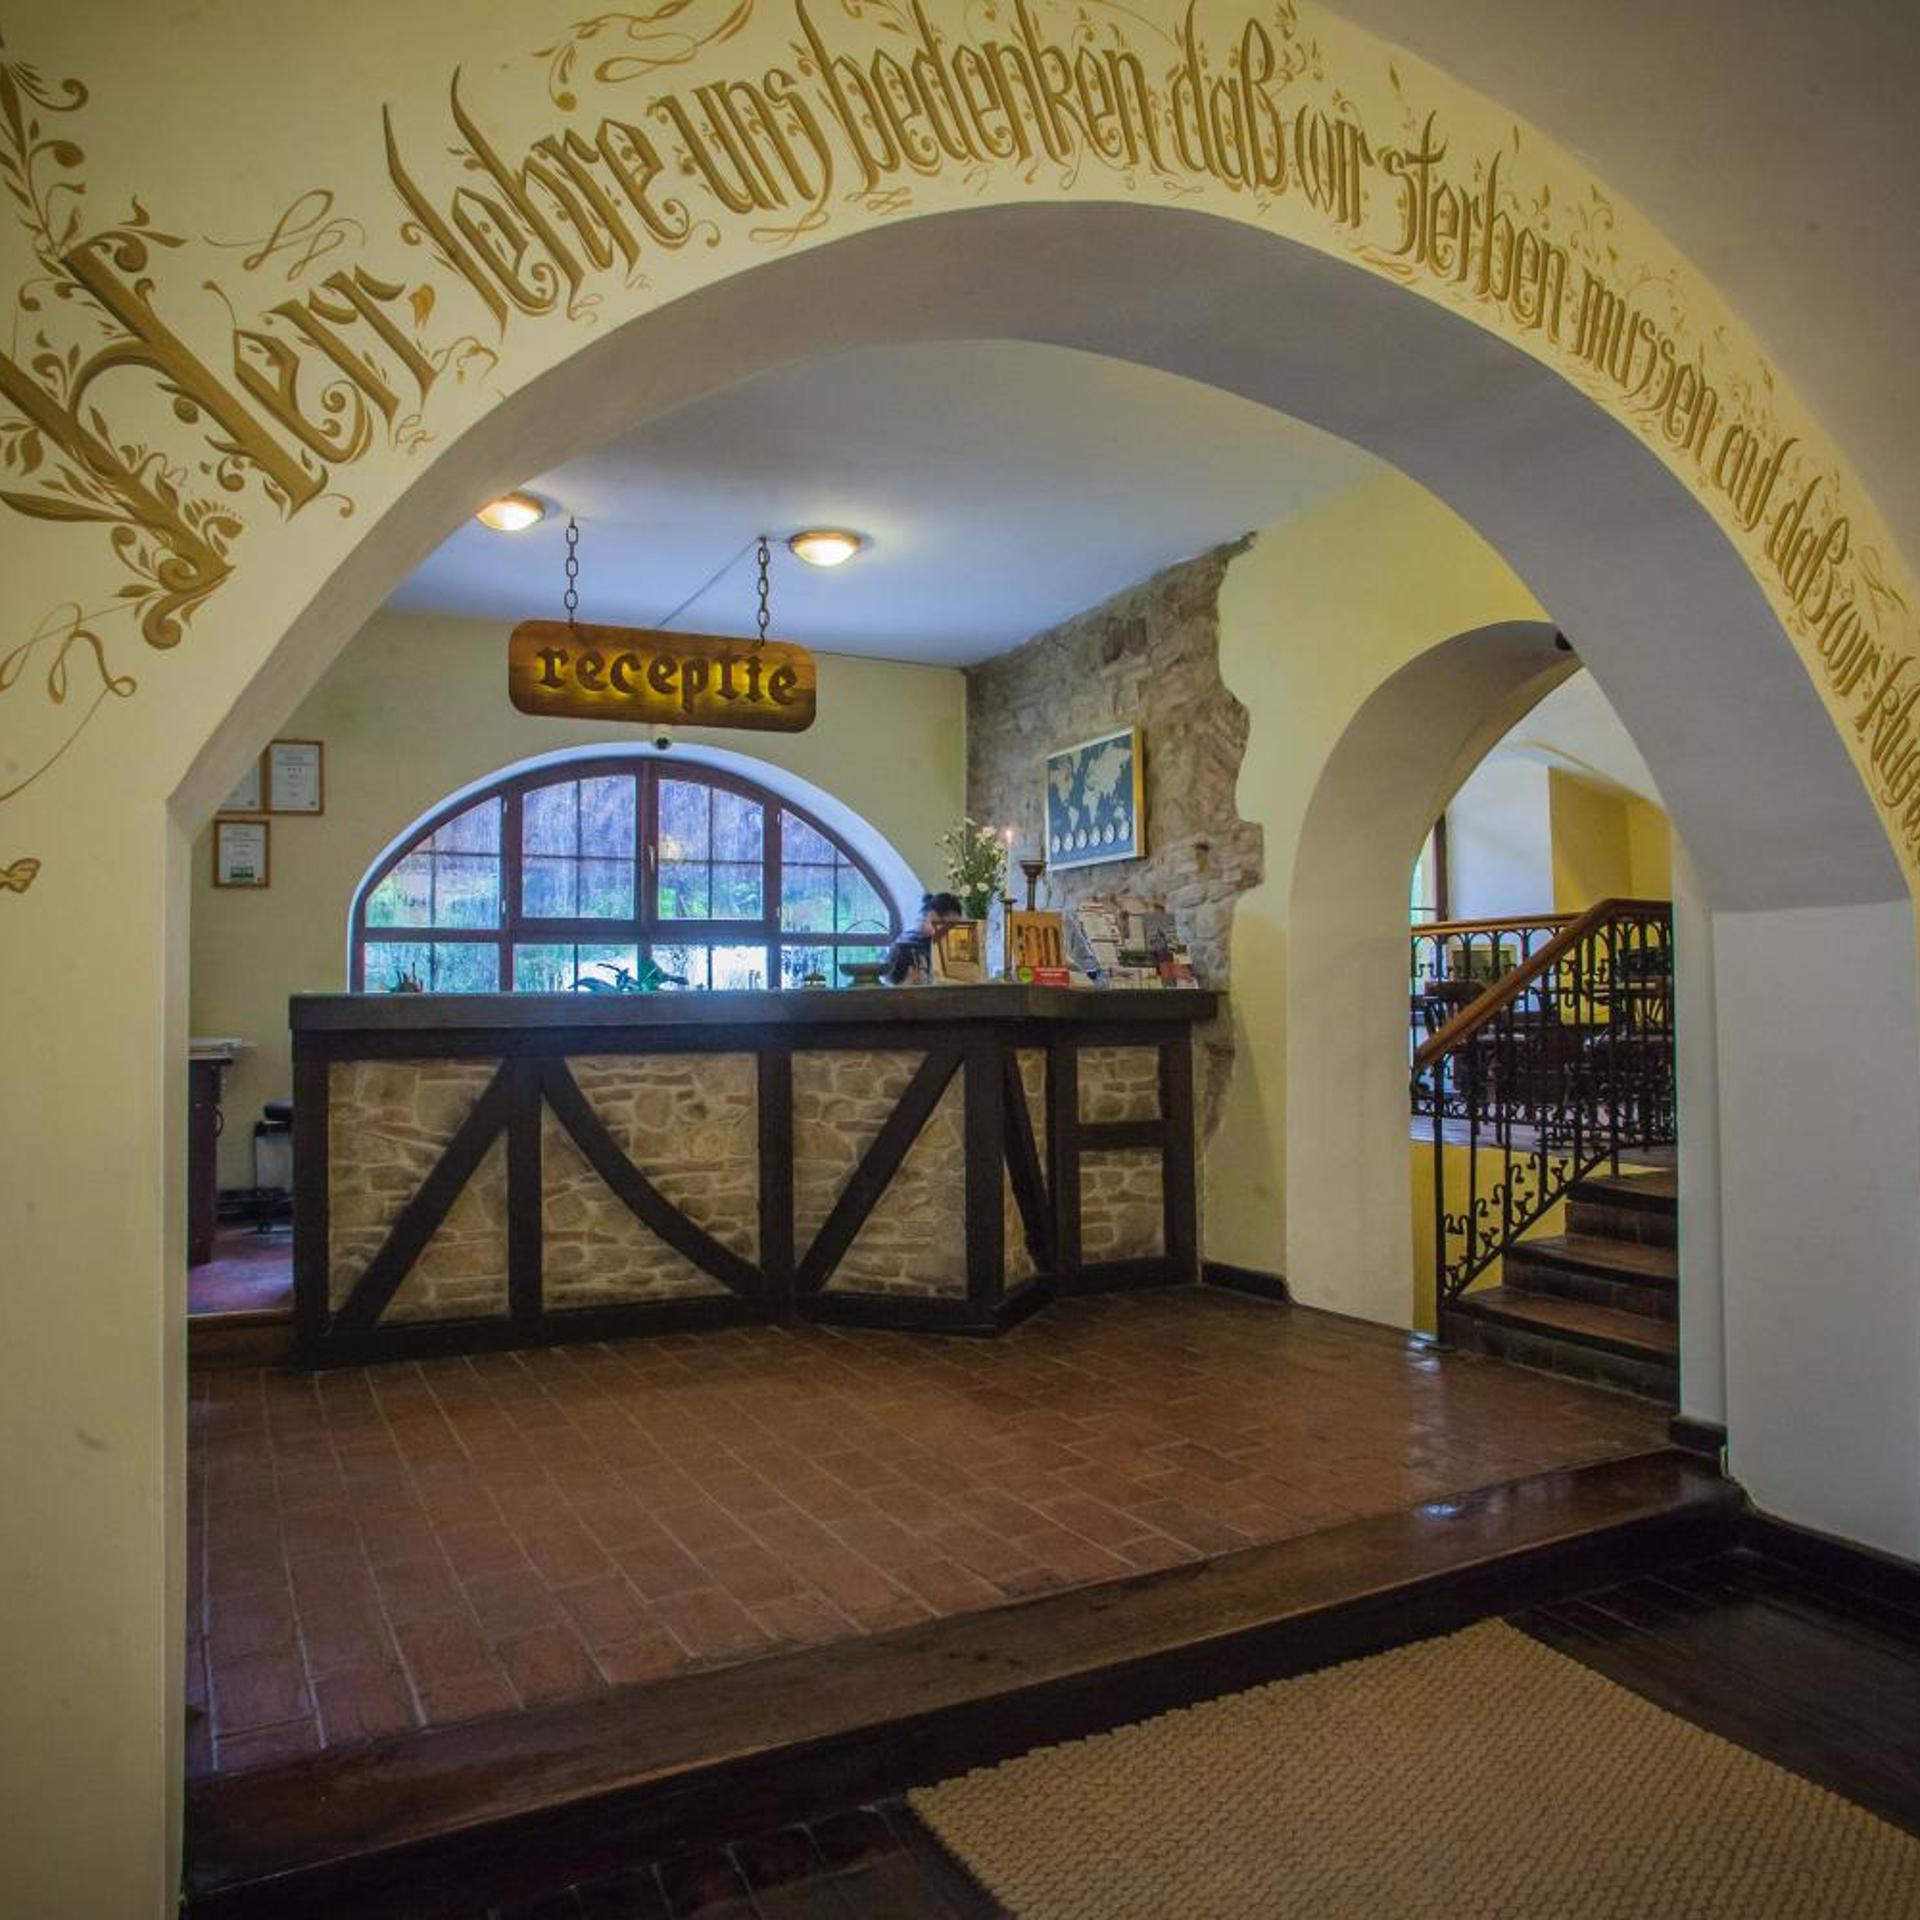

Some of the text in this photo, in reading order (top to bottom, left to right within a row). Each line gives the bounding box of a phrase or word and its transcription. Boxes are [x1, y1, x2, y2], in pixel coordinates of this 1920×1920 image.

[382, 65, 692, 345] lehre
[646, 68, 833, 240] uns
[795, 0, 1172, 195] bedenken
[1165, 0, 1290, 194] daß
[1294, 103, 1374, 230] wir
[1380, 110, 1566, 346] sterben
[1714, 424, 1801, 533] auf
[1765, 475, 1849, 625] daß
[1818, 600, 1881, 697] wir
[535, 647, 799, 713] receptie
